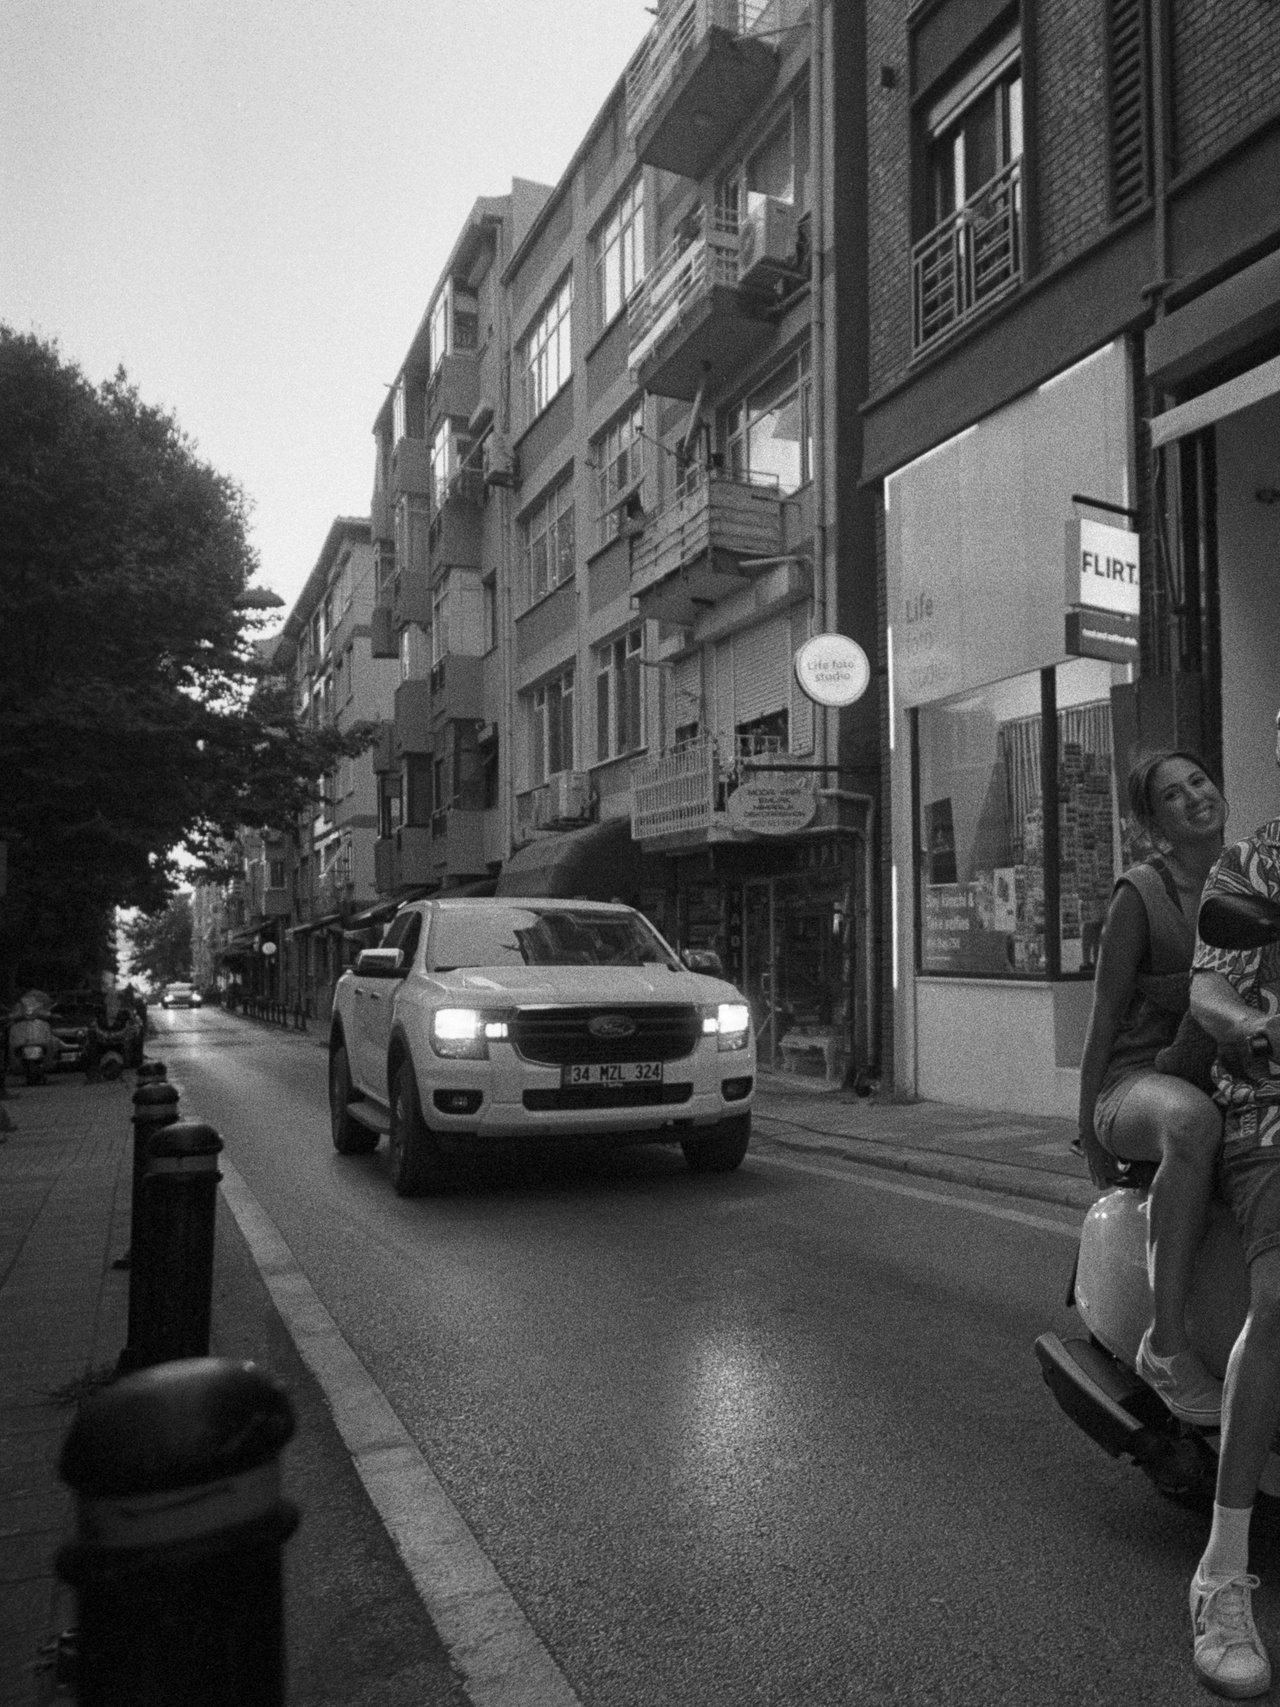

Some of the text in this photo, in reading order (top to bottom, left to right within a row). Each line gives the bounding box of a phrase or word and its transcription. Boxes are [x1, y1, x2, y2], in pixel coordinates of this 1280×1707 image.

[1082, 551, 1139, 586] FLIRT.
[905, 592, 934, 624] Life
[807, 659, 855, 671] Life foto
[815, 671, 852, 682] studio
[573, 1063, 660, 1082] 34 MZL 324
